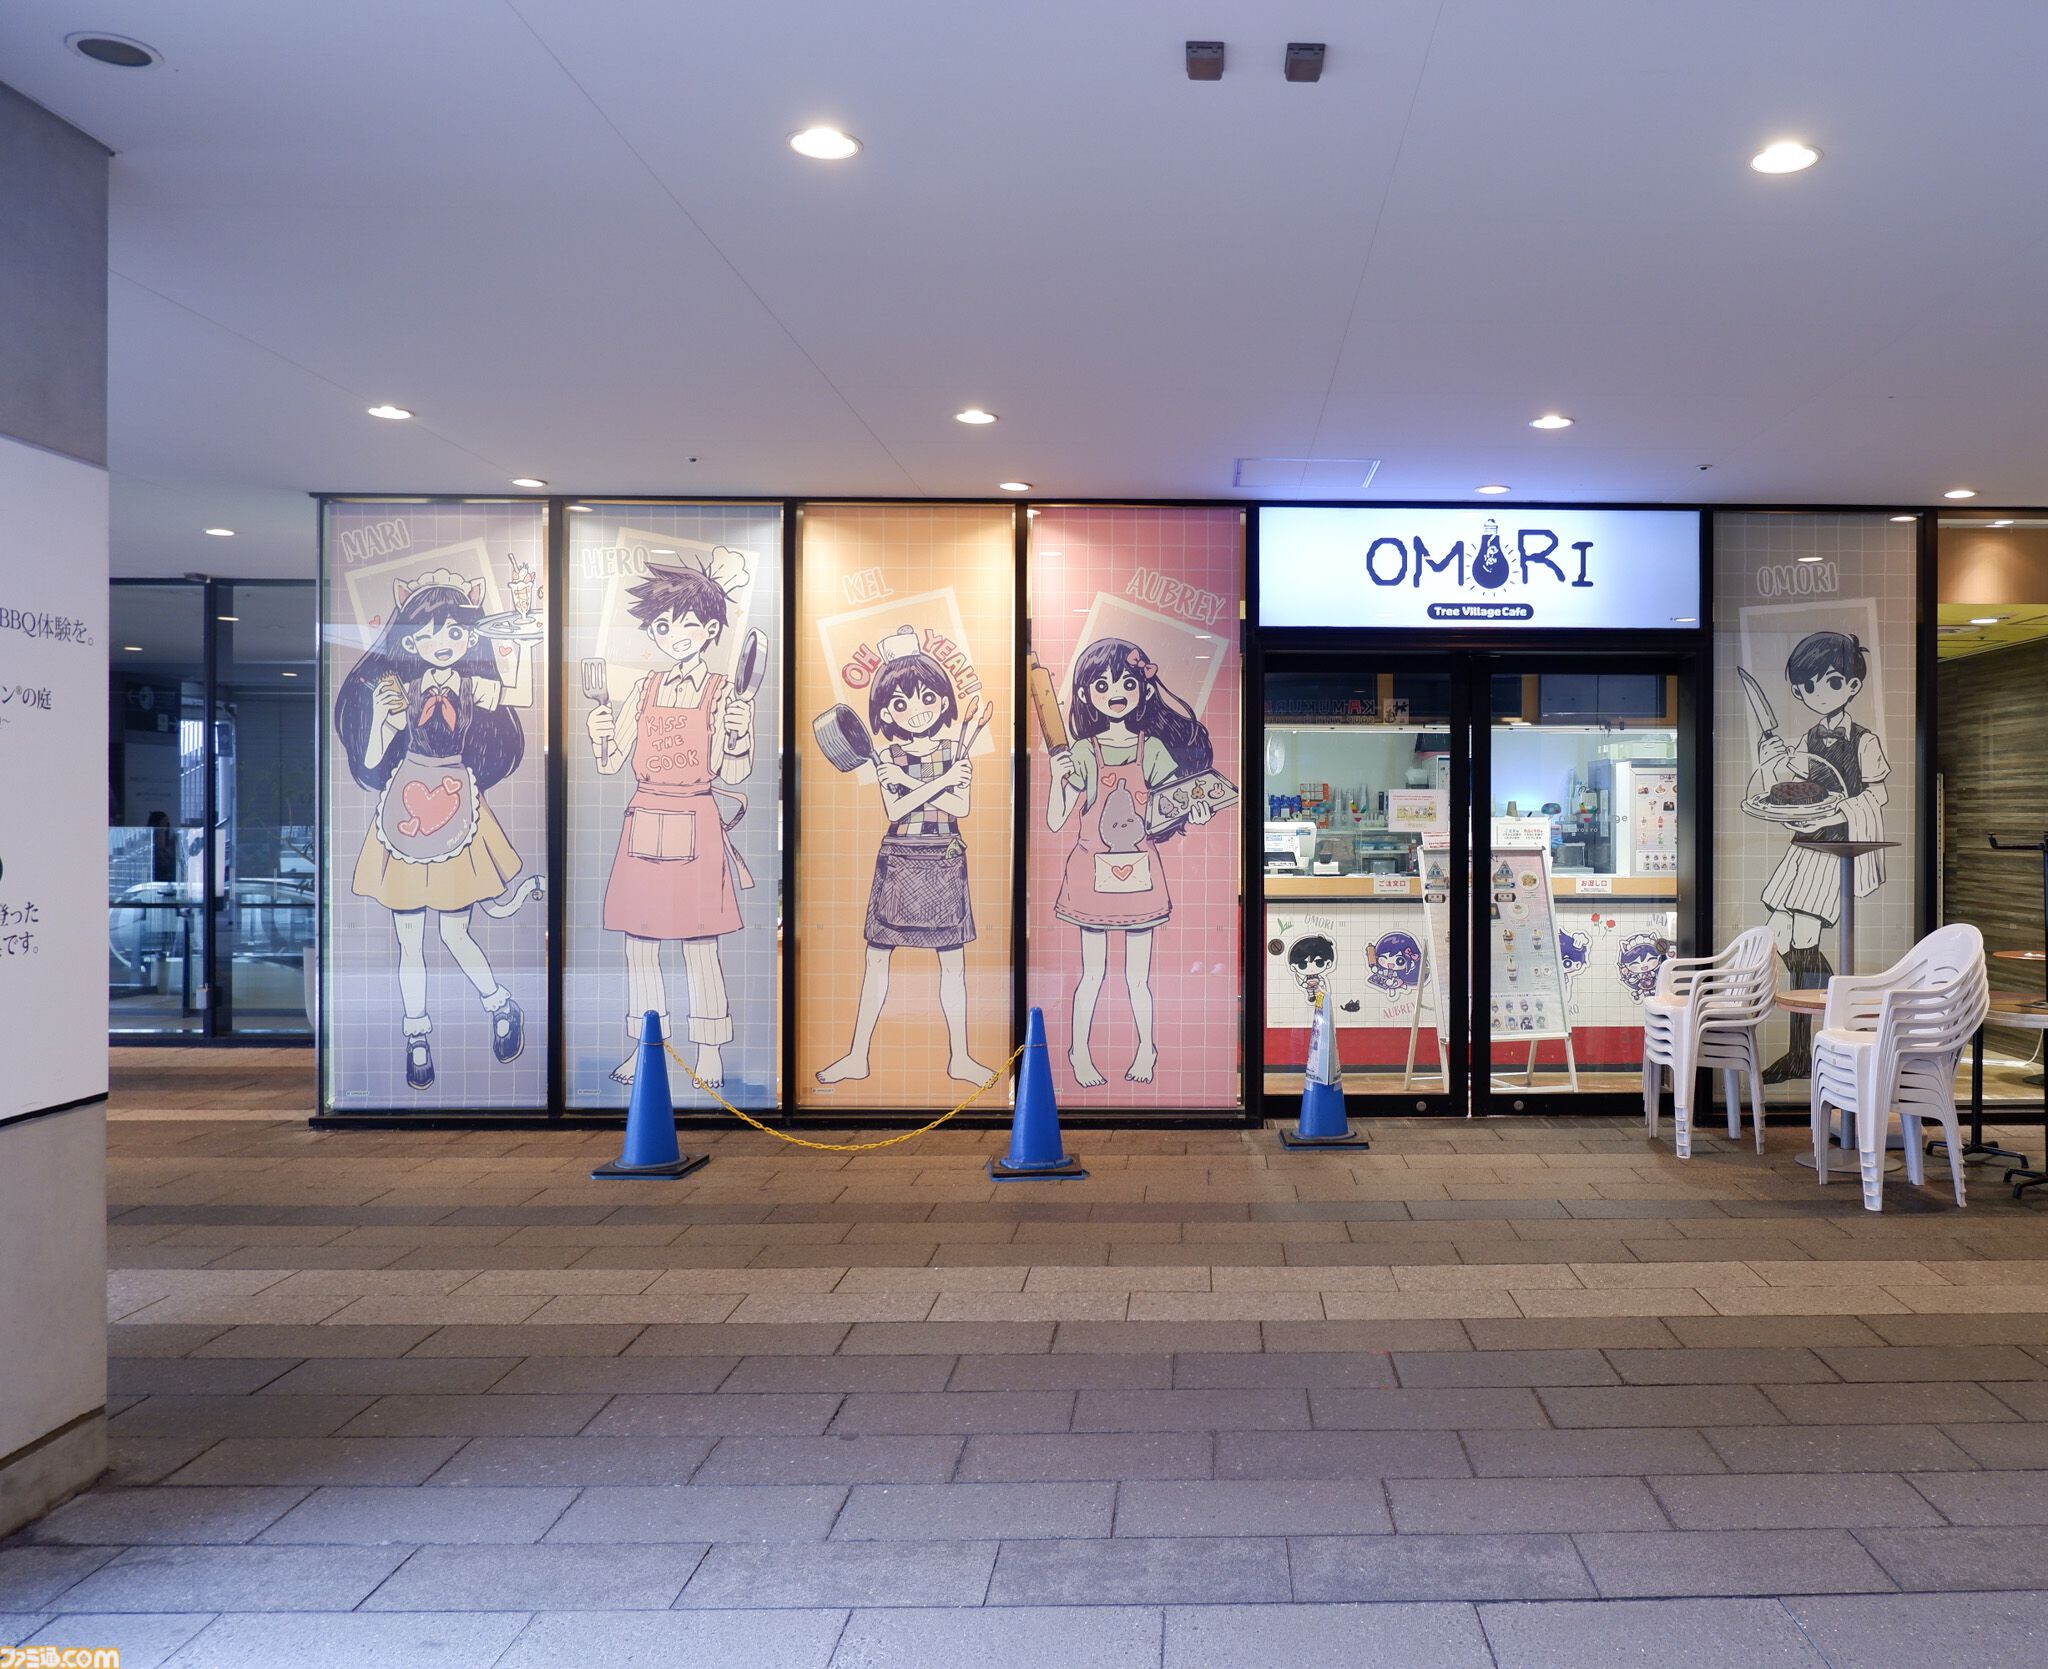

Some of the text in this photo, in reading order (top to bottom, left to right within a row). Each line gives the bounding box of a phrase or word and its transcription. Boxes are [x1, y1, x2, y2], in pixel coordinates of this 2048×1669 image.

[341, 518, 410, 563] MARI
[582, 545, 650, 579] HERO
[842, 566, 895, 605] KEL
[1126, 567, 1226, 626] AUBREY
[1757, 562, 1838, 597] OMORI
[1433, 606, 1527, 618] Tree Village Cafe
[842, 629, 982, 700] OH YEAH!
[646, 715, 687, 737] KISS
[652, 735, 684, 751] THE
[646, 750, 699, 773] COOK
[1304, 914, 1335, 930] OMORI
